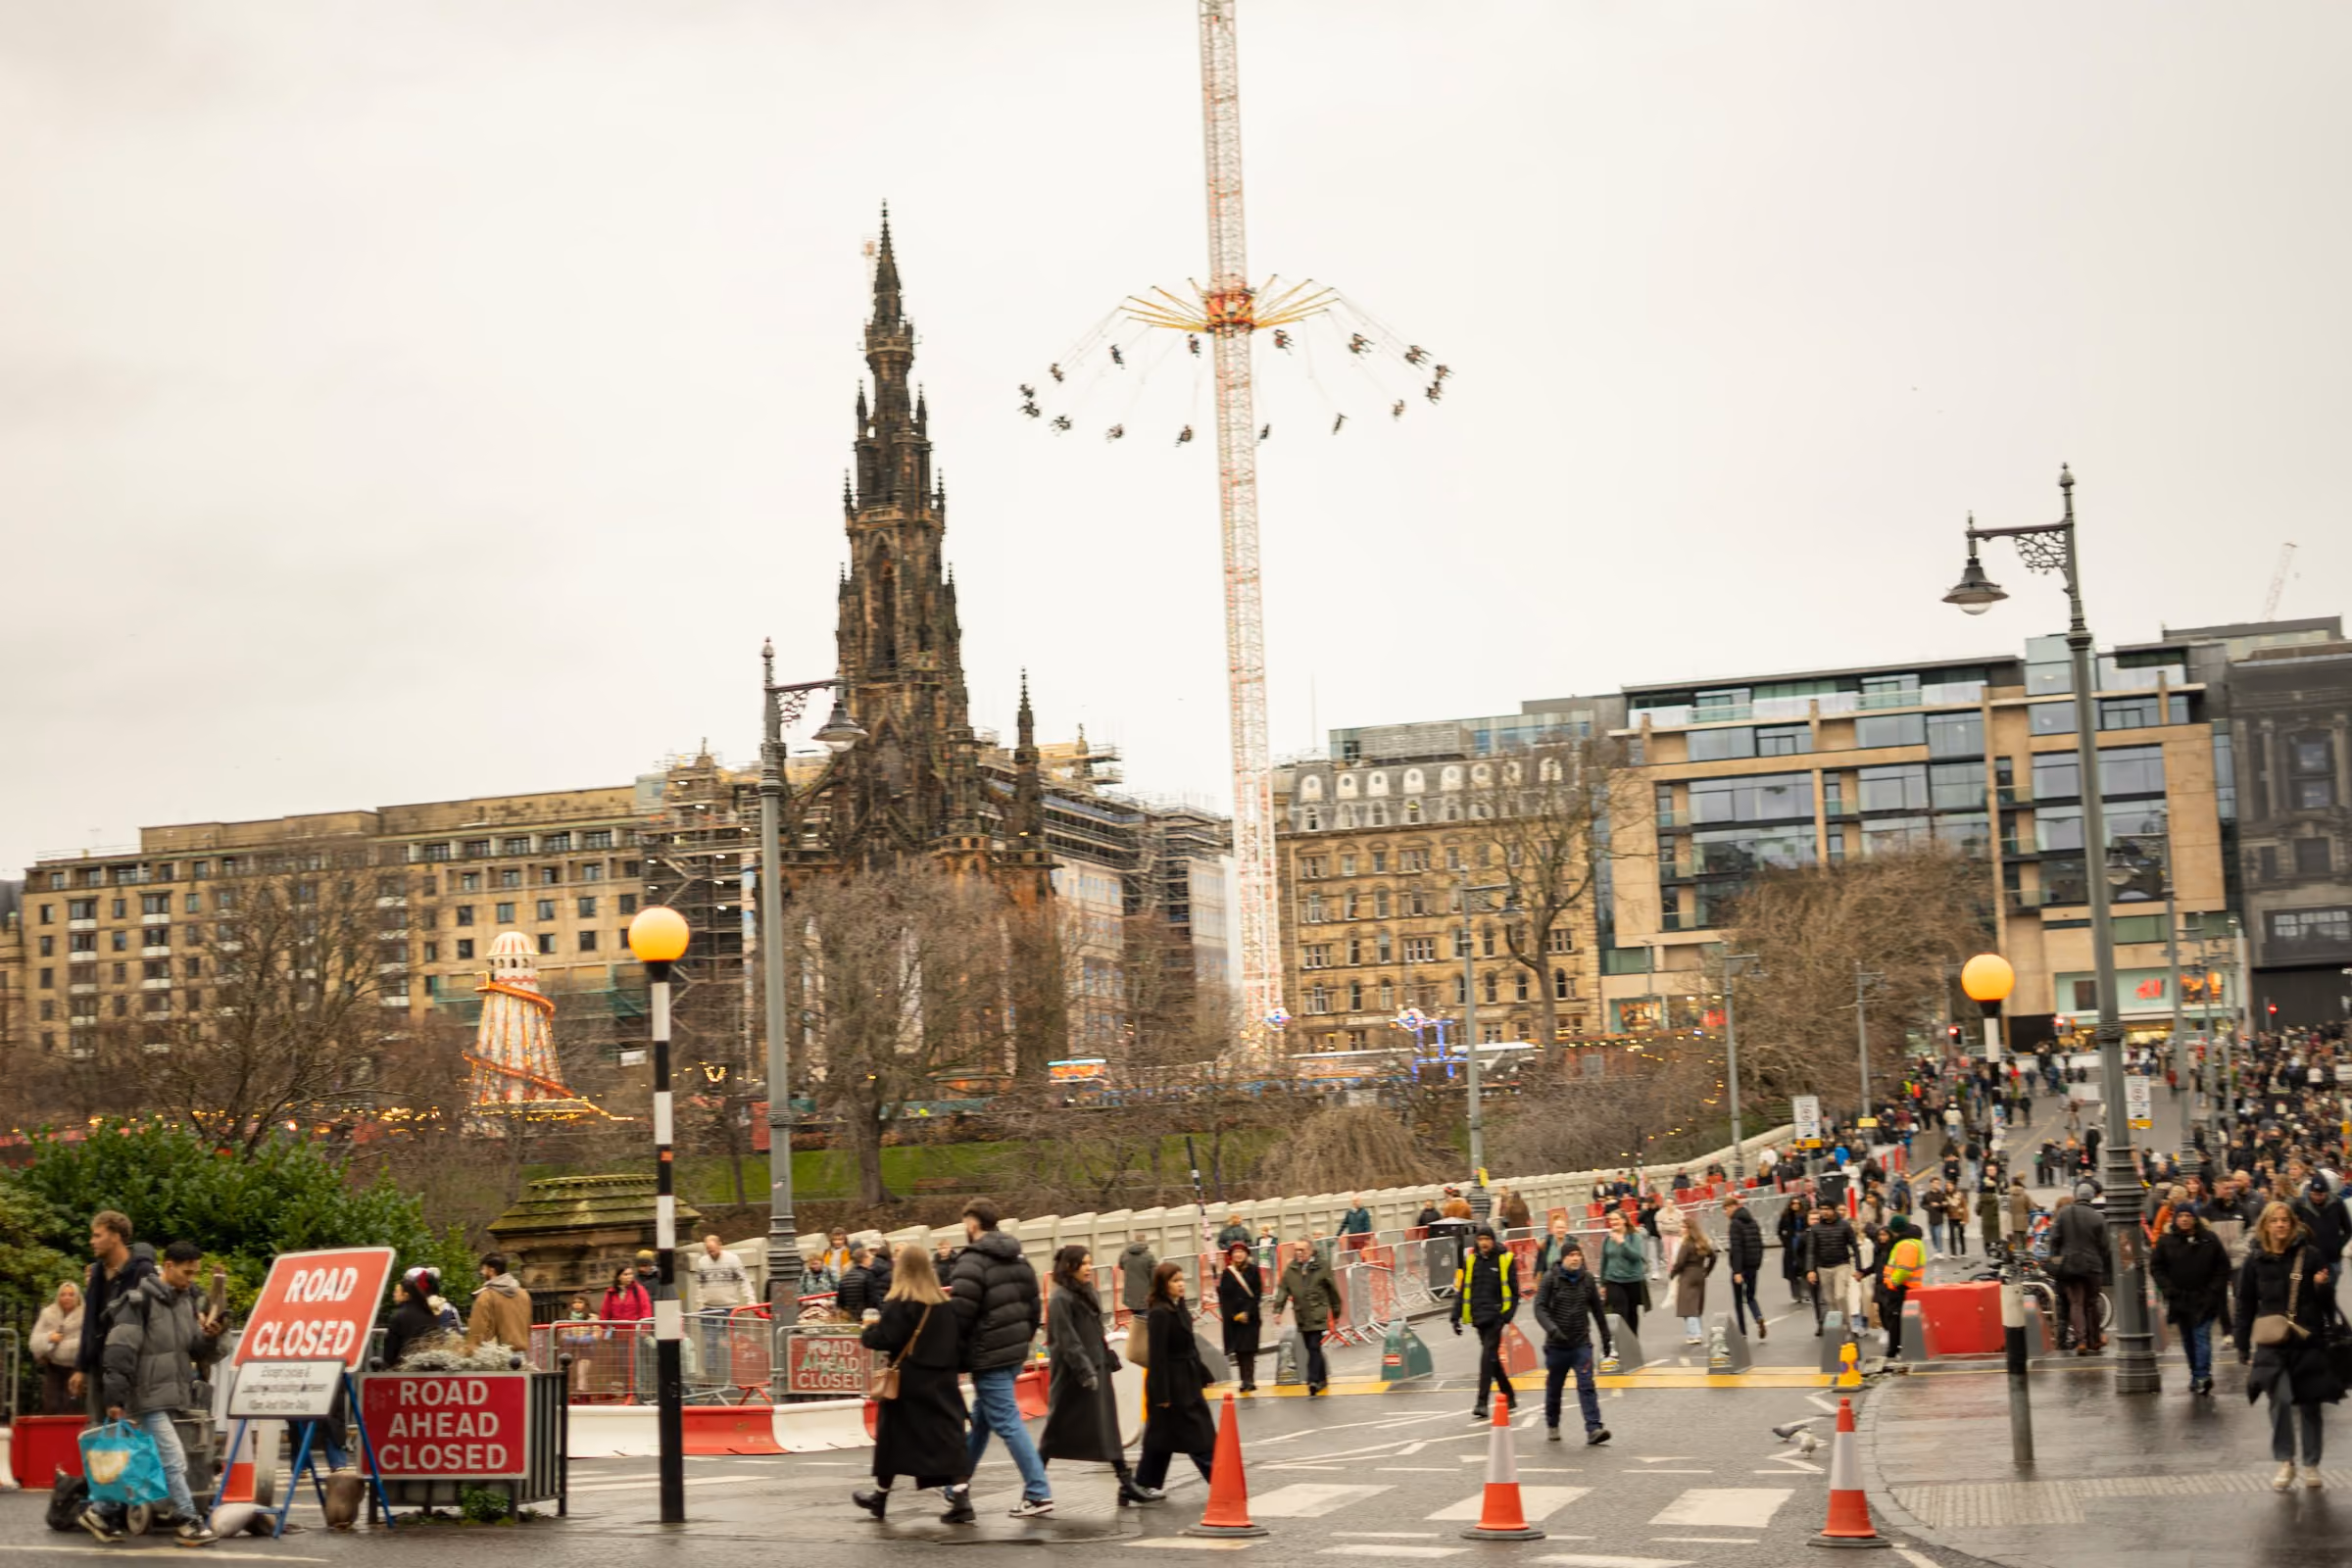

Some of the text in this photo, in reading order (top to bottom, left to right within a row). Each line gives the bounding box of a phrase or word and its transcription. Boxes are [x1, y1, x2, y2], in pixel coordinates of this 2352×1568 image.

[283, 1267, 359, 1302] ROAD
[251, 1320, 356, 1356] CLOSED
[400, 1380, 488, 1406] ROAD
[797, 1373, 862, 1388] CLOSED
[388, 1411, 499, 1438] AHEAD
[379, 1444, 508, 1470] CLOSED
